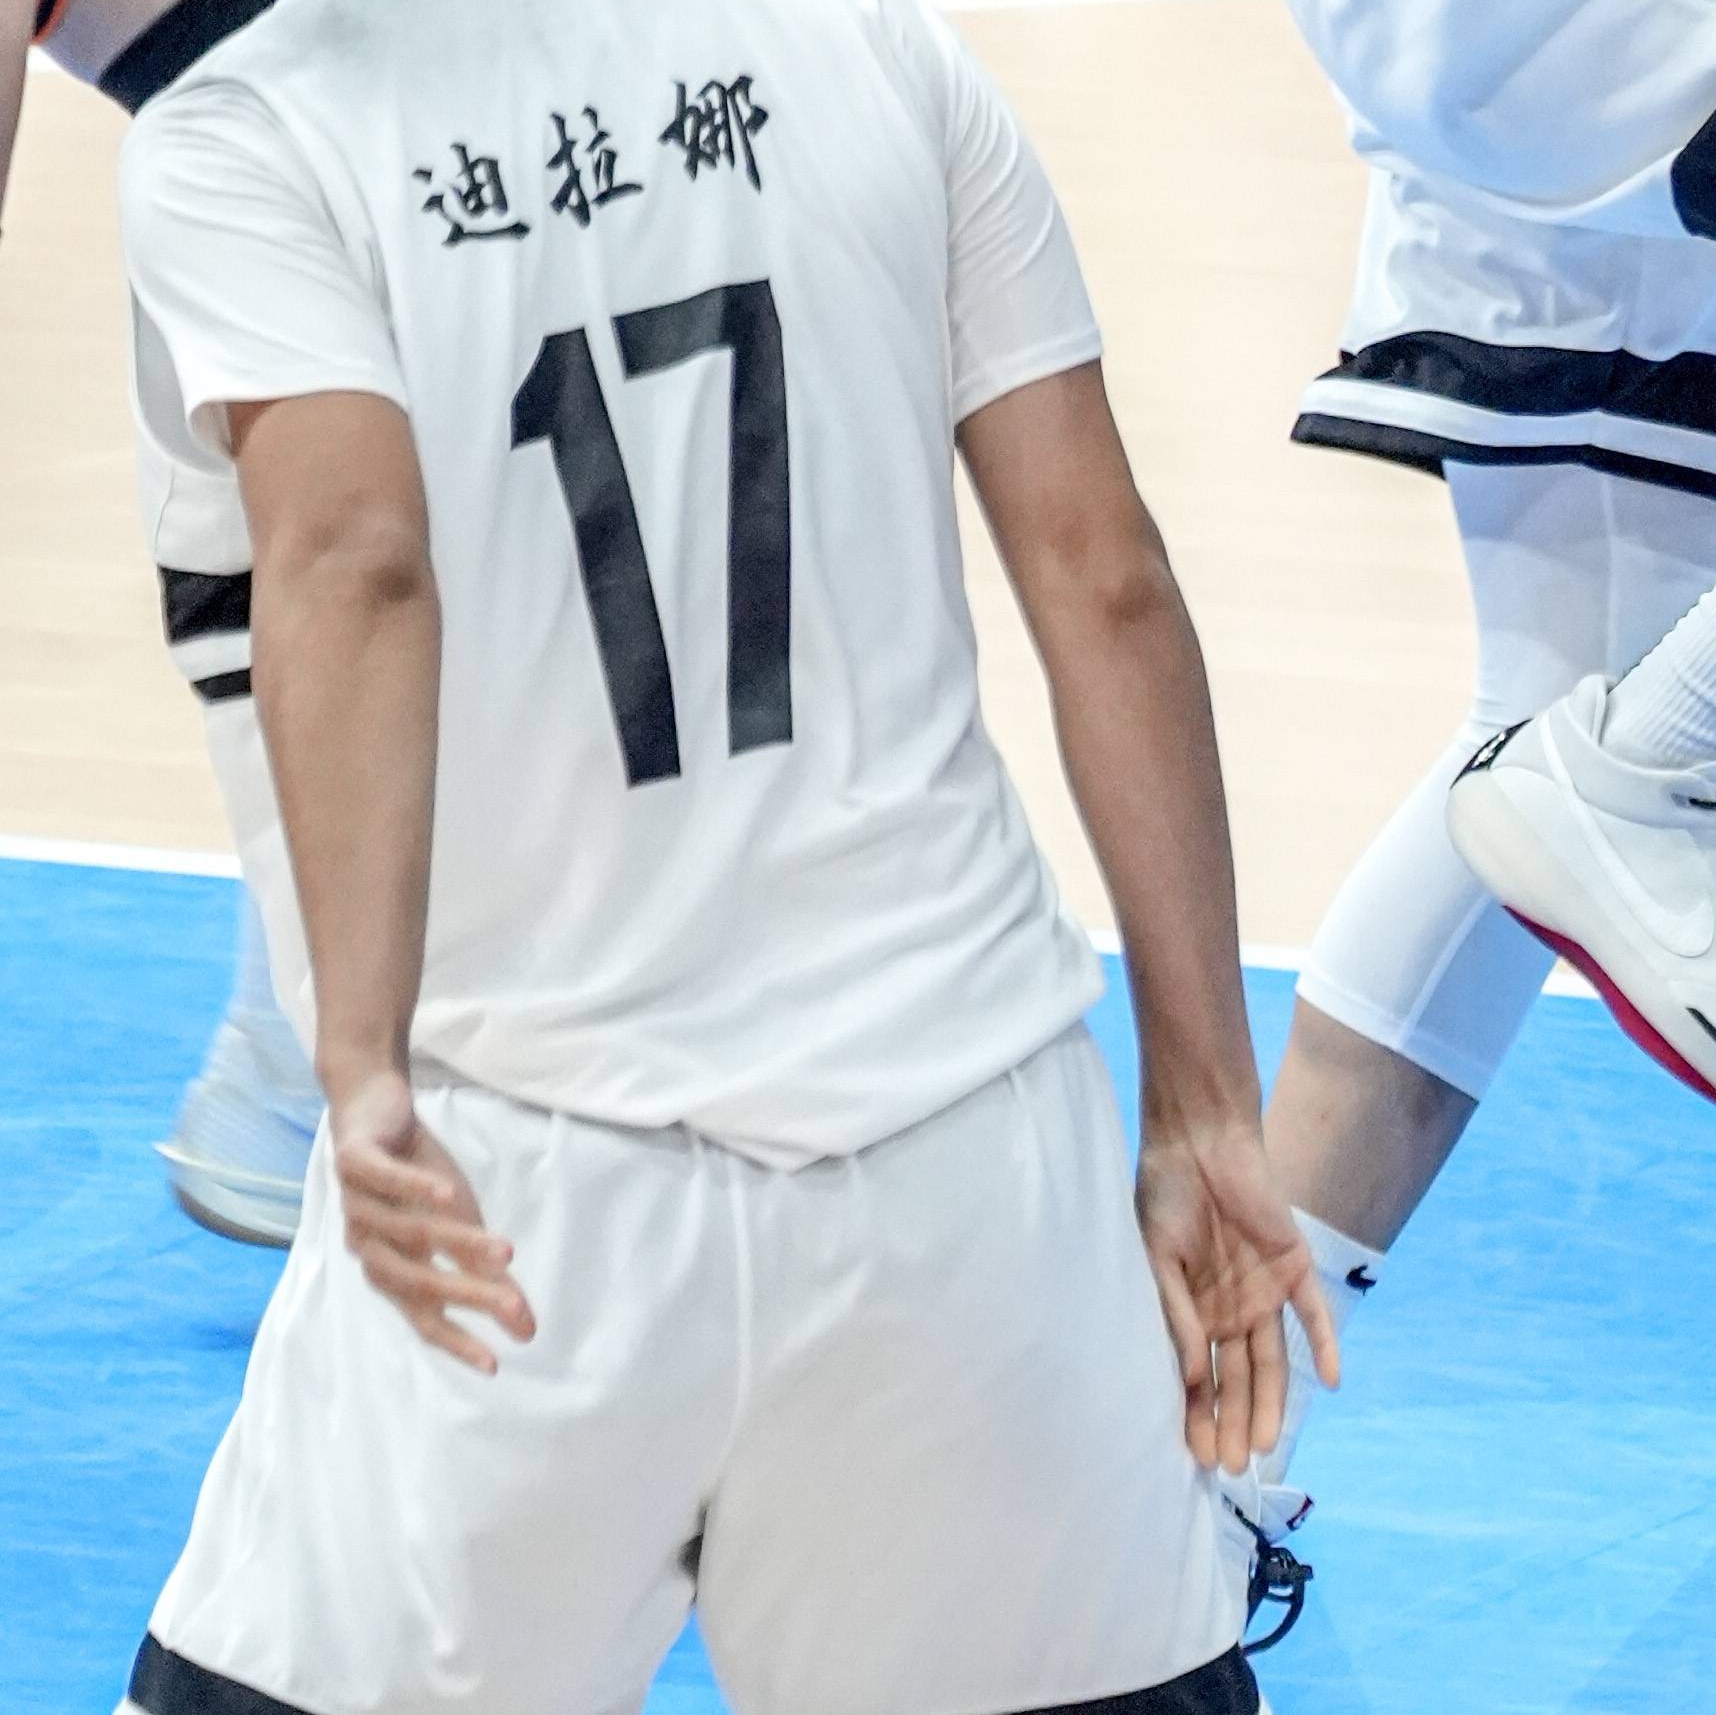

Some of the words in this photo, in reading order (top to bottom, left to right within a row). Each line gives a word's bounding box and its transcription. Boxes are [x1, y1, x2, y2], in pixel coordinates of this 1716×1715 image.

[411, 73, 770, 246] 迪拉娜
[510, 278, 794, 791] 17
